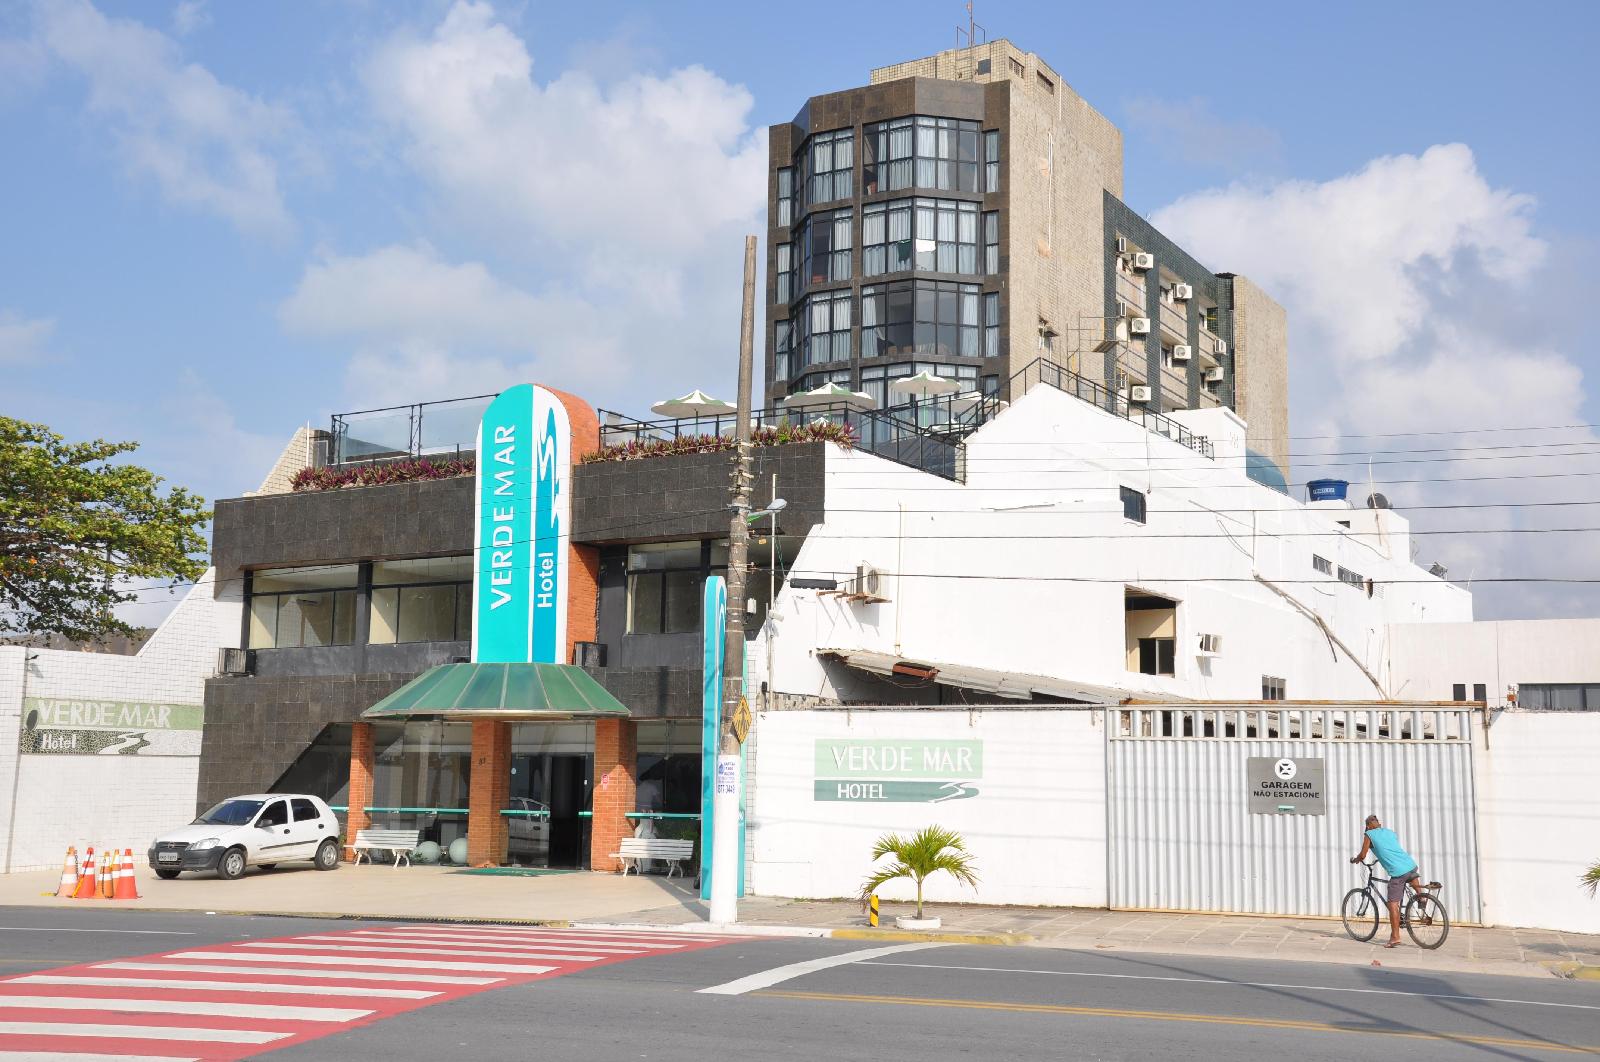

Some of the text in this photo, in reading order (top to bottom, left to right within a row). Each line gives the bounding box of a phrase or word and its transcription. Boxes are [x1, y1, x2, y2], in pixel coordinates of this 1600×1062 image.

[490, 425, 516, 610] VERDE MAR
[537, 552, 554, 608] Hotel
[37, 699, 172, 729] VERDE MAR
[40, 733, 78, 750] Hotel
[831, 746, 974, 772] VERDE MAR
[837, 783, 889, 799] HOTEL
[1261, 781, 1312, 790] GARAGEM
[1273, 791, 1320, 799] ESTACIONE
